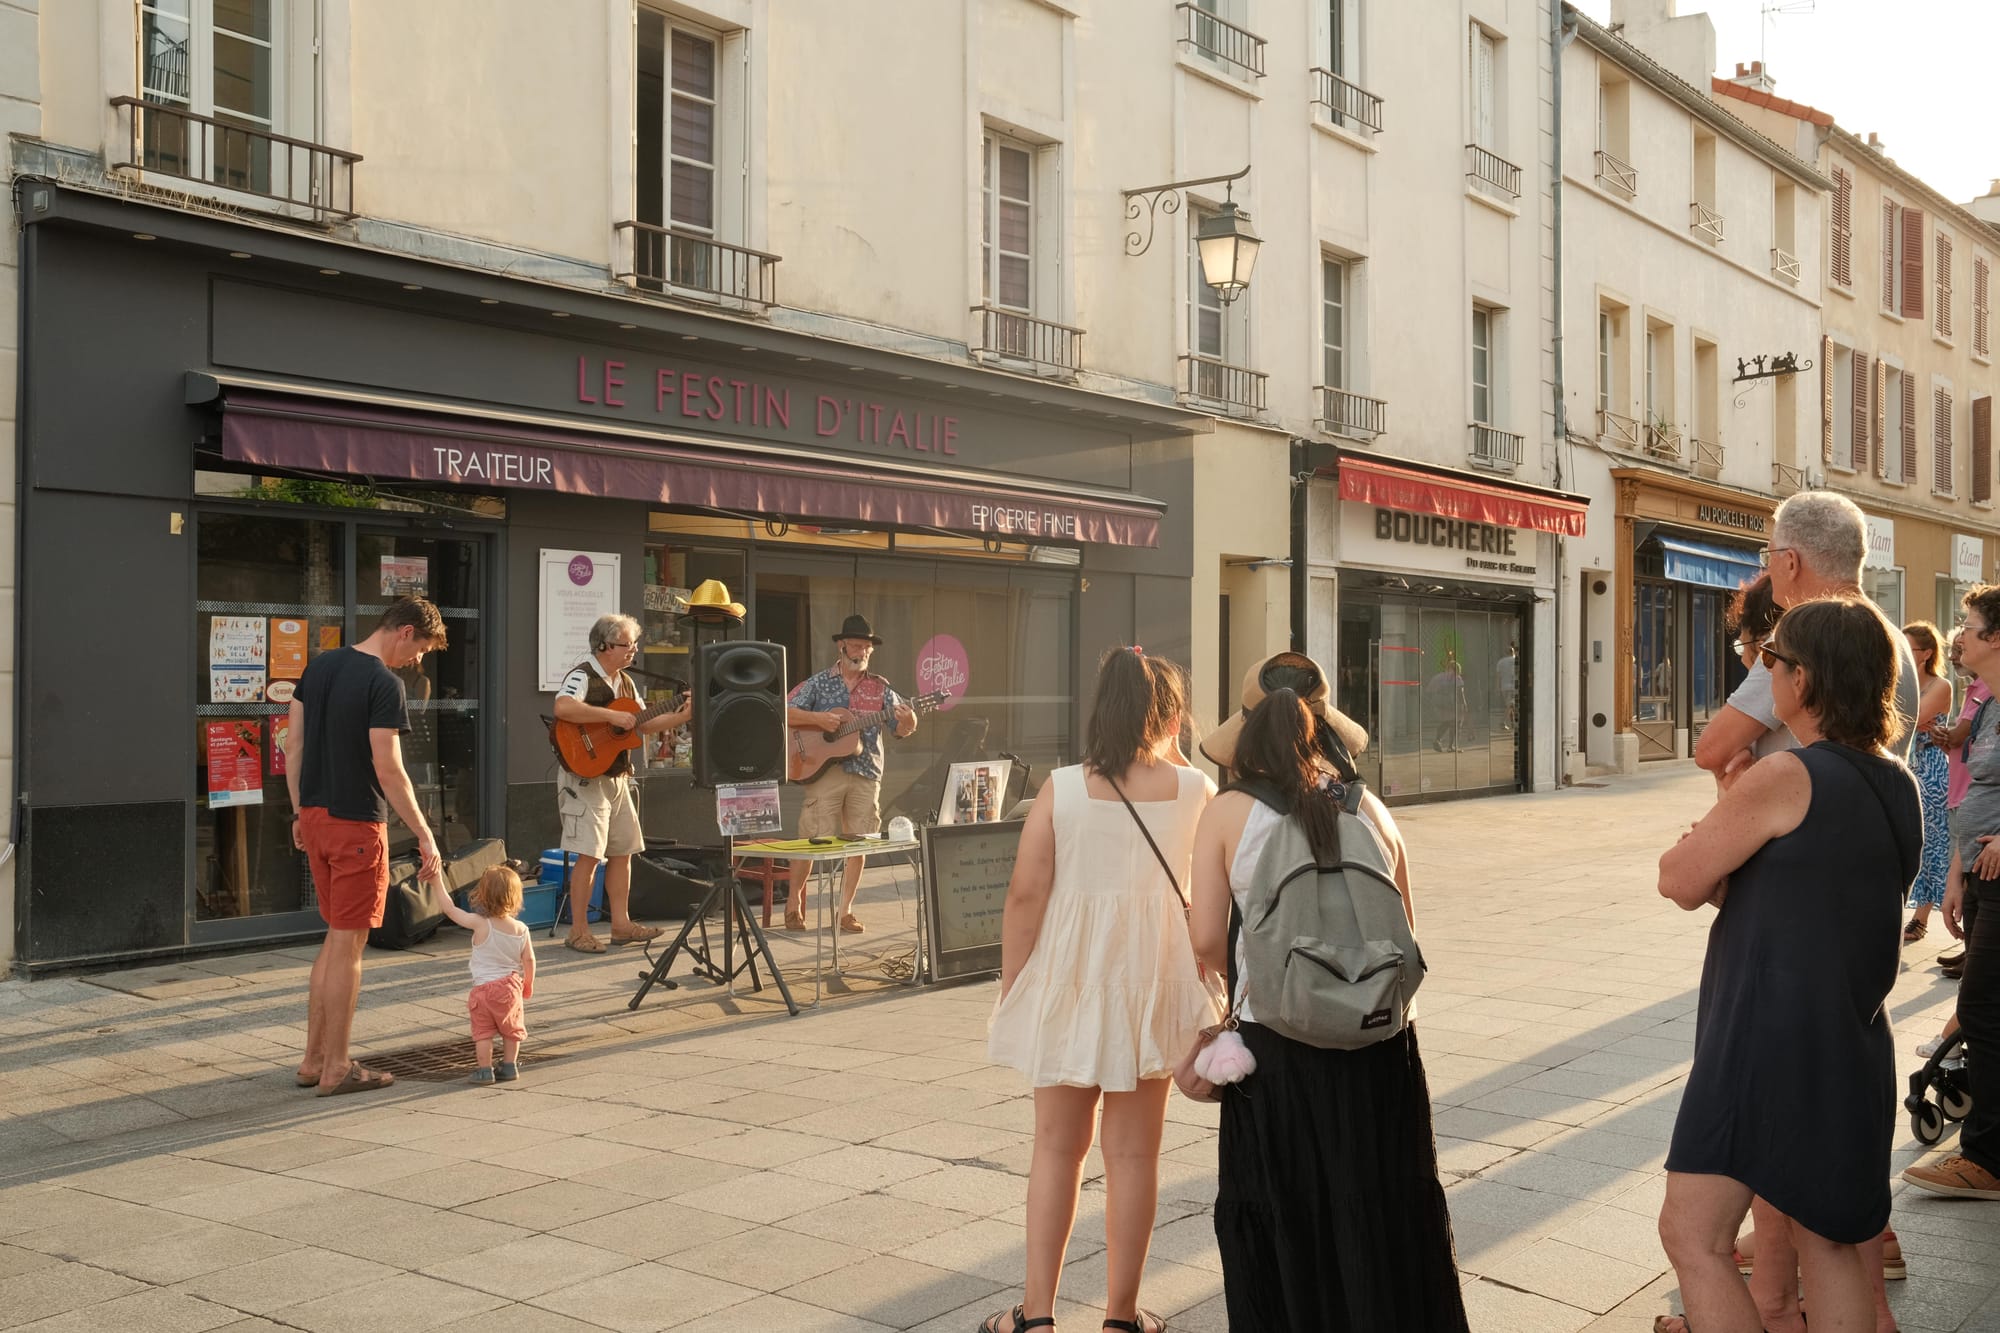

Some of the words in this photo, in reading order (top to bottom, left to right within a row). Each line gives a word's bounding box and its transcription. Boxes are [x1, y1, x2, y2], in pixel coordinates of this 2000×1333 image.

[577, 354, 626, 407] LE
[655, 368, 790, 431] FESTIN
[816, 394, 960, 456] D'ITALIE
[433, 447, 552, 484] TRAITEUR
[972, 504, 1037, 531] EPICERIE
[1043, 512, 1075, 536] FINE
[1374, 508, 1517, 557] BOUCHERIE
[1700, 504, 1711, 521] AU
[1712, 506, 1748, 530] PORCELET
[1959, 541, 1981, 568] Etam
